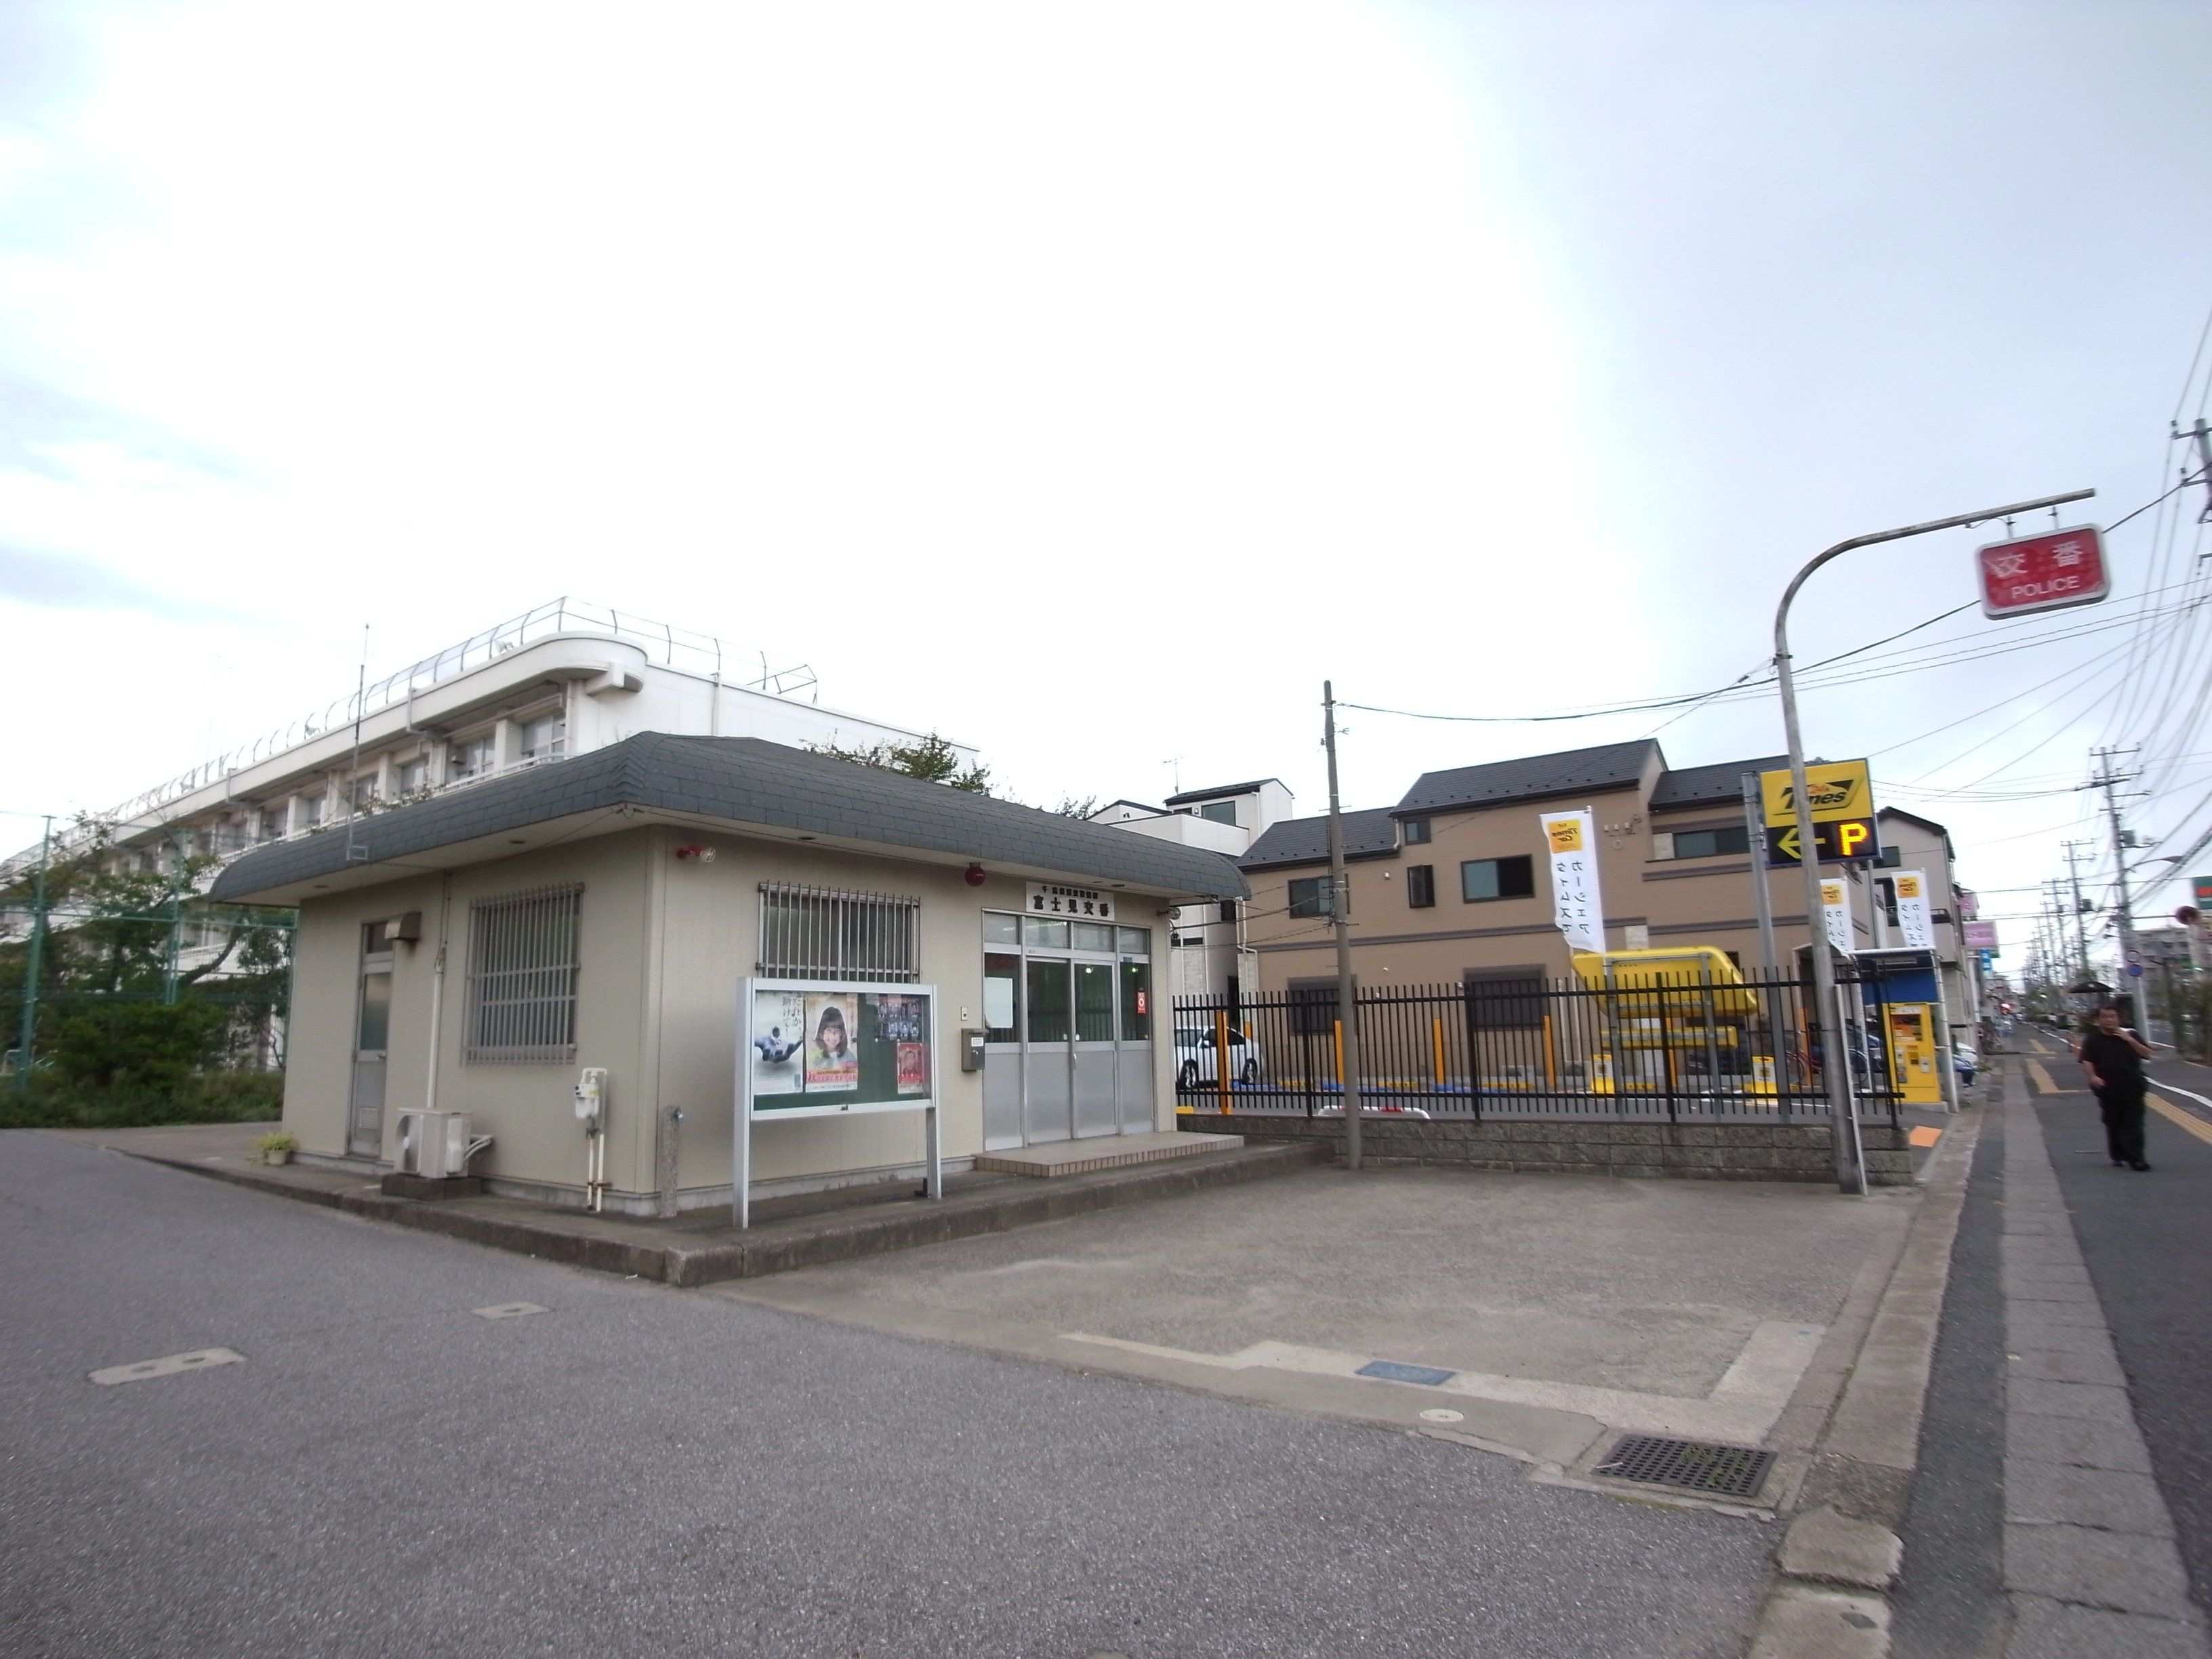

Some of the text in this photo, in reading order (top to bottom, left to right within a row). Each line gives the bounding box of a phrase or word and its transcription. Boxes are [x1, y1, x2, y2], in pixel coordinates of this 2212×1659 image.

[1998, 540, 2083, 576] 交番
[2011, 575, 2080, 599] POLICE
[1838, 823, 1867, 857] P
[1033, 895, 1109, 917] 富士見交番
